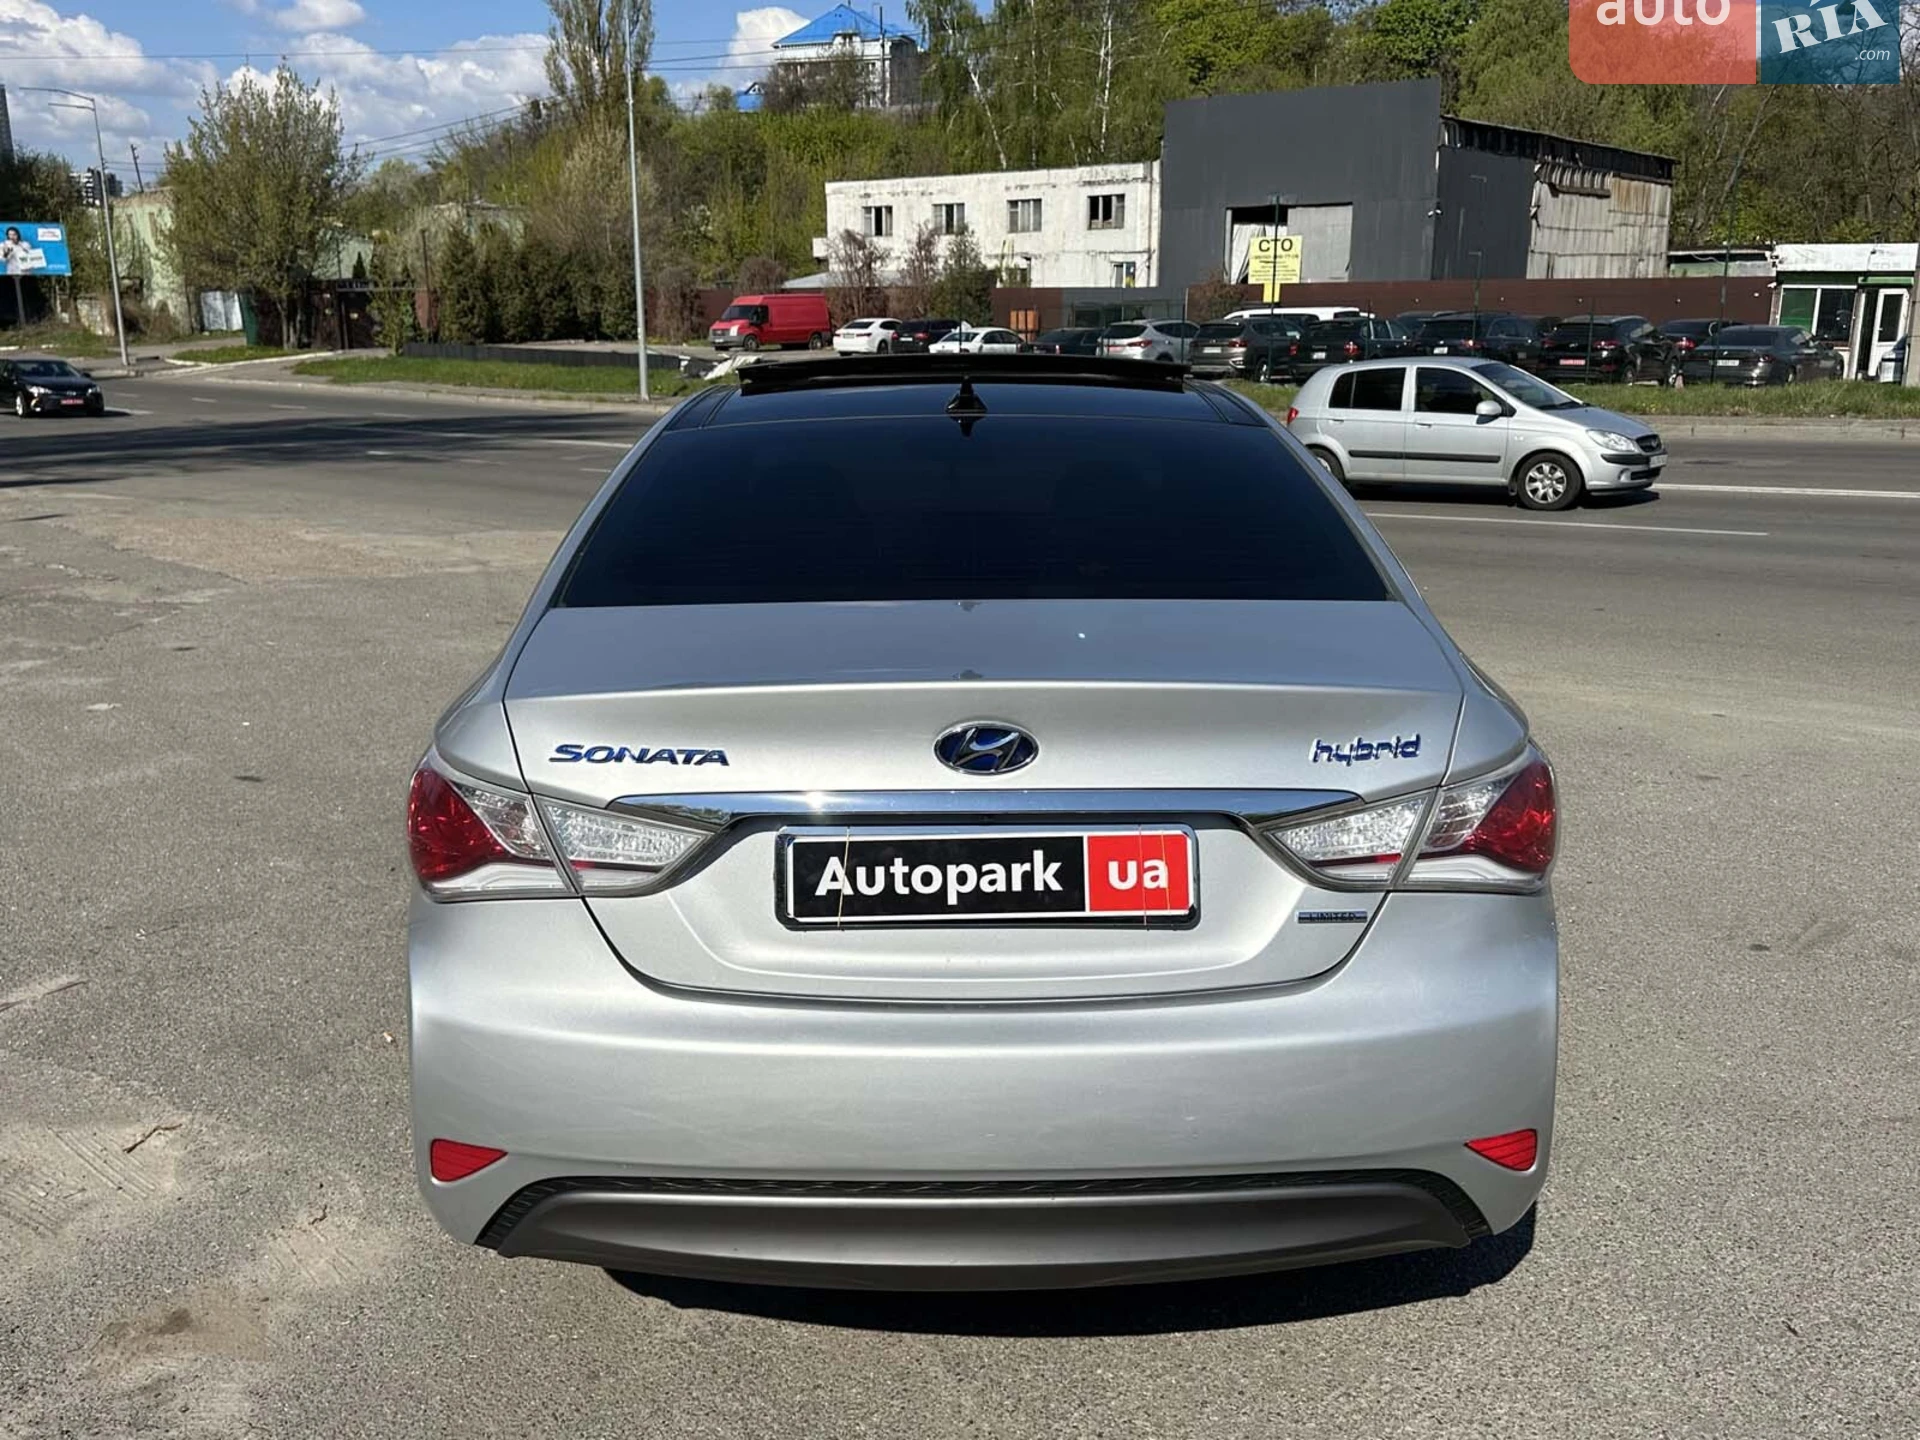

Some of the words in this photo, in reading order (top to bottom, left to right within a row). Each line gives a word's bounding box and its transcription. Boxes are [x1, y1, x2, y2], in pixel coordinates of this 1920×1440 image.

[1258, 238, 1293, 253] СТО
[549, 744, 730, 766] SONATA
[1310, 733, 1421, 766] hybrid
[814, 849, 1063, 905] Autopark
[1107, 857, 1169, 890] ua
